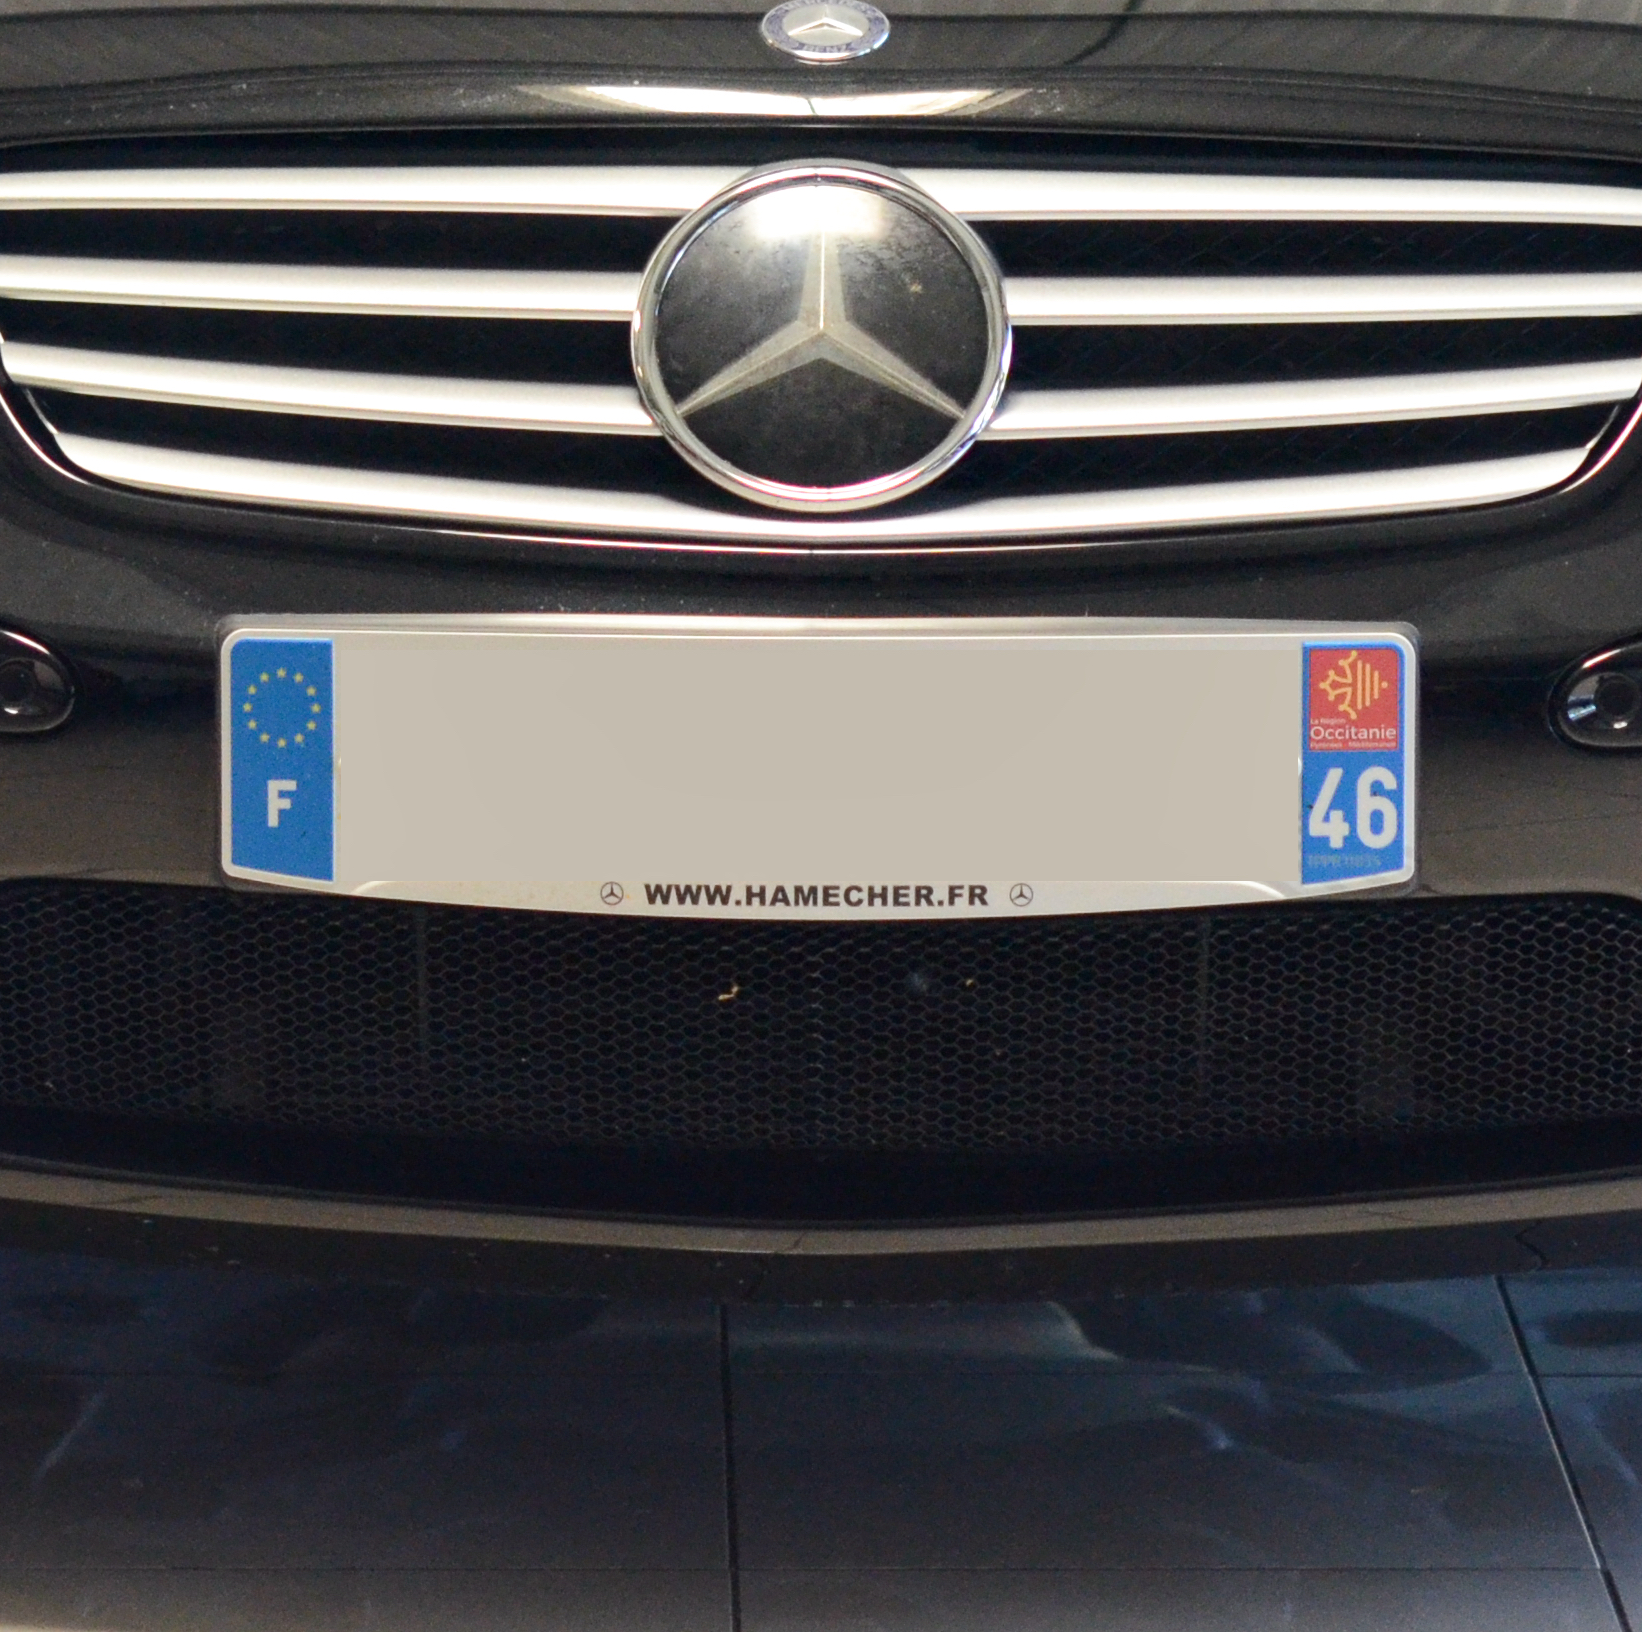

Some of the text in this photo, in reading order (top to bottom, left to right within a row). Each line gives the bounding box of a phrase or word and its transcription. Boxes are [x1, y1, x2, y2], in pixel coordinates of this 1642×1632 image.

[1310, 724, 1397, 740] Occitanie
[267, 779, 297, 827] F
[1308, 766, 1398, 849] 46
[644, 883, 989, 908] WWW.HAMECHER.FR
